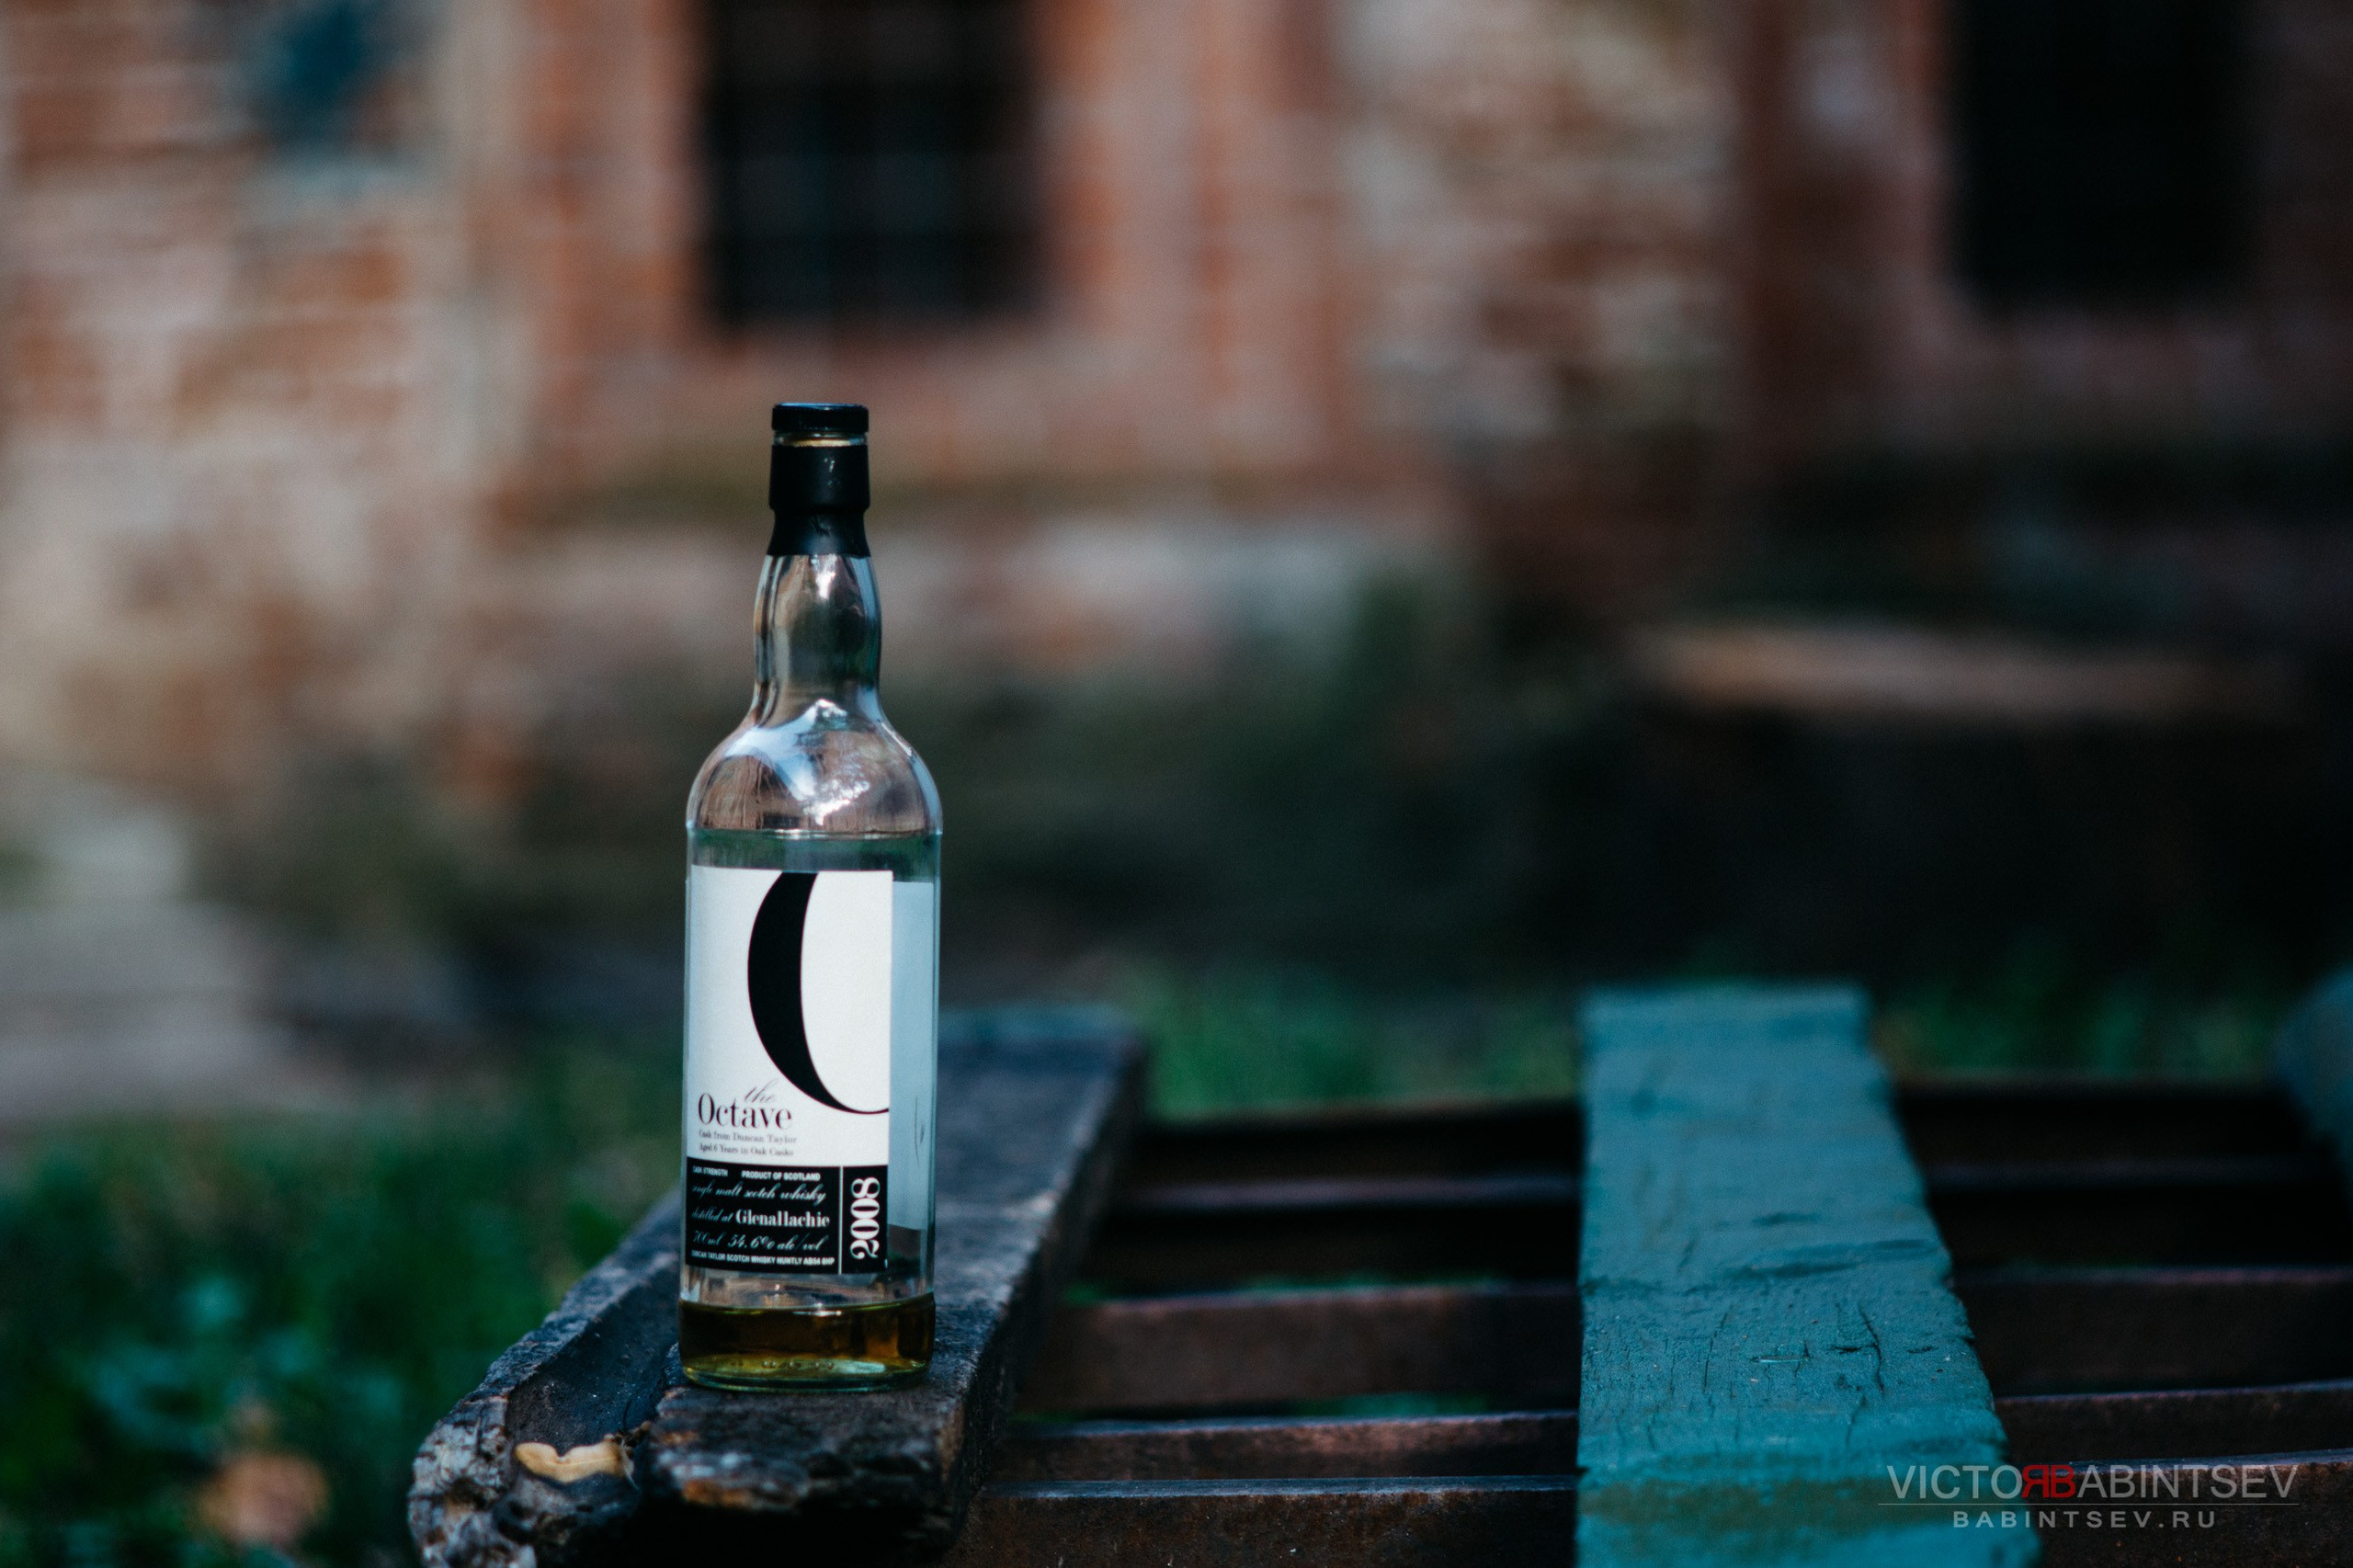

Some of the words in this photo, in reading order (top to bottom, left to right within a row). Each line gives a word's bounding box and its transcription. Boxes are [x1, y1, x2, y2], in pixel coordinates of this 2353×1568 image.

[744, 1078, 779, 1102] the
[698, 1092, 792, 1130] Octave
[713, 1130, 731, 1141] from
[733, 1131, 765, 1142] Duncan
[767, 1133, 797, 1145] Taylor
[719, 1144, 739, 1154] Years
[740, 1145, 748, 1155] in
[750, 1147, 767, 1155] Oak
[703, 1166, 729, 1177] STRENGTH
[741, 1169, 772, 1179] PRODUCT
[772, 1171, 782, 1181] OF
[783, 1171, 822, 1182] SCOTLAND
[715, 1181, 744, 1197] malt
[780, 1183, 826, 1206] whisky
[721, 1212, 734, 1223] at
[735, 1209, 831, 1228] Glenallachie
[850, 1176, 881, 1260] 2008
[726, 1253, 750, 1264] SCOTCH
[750, 1255, 776, 1265] WHISKY
[776, 1256, 802, 1266] HUNTLY
